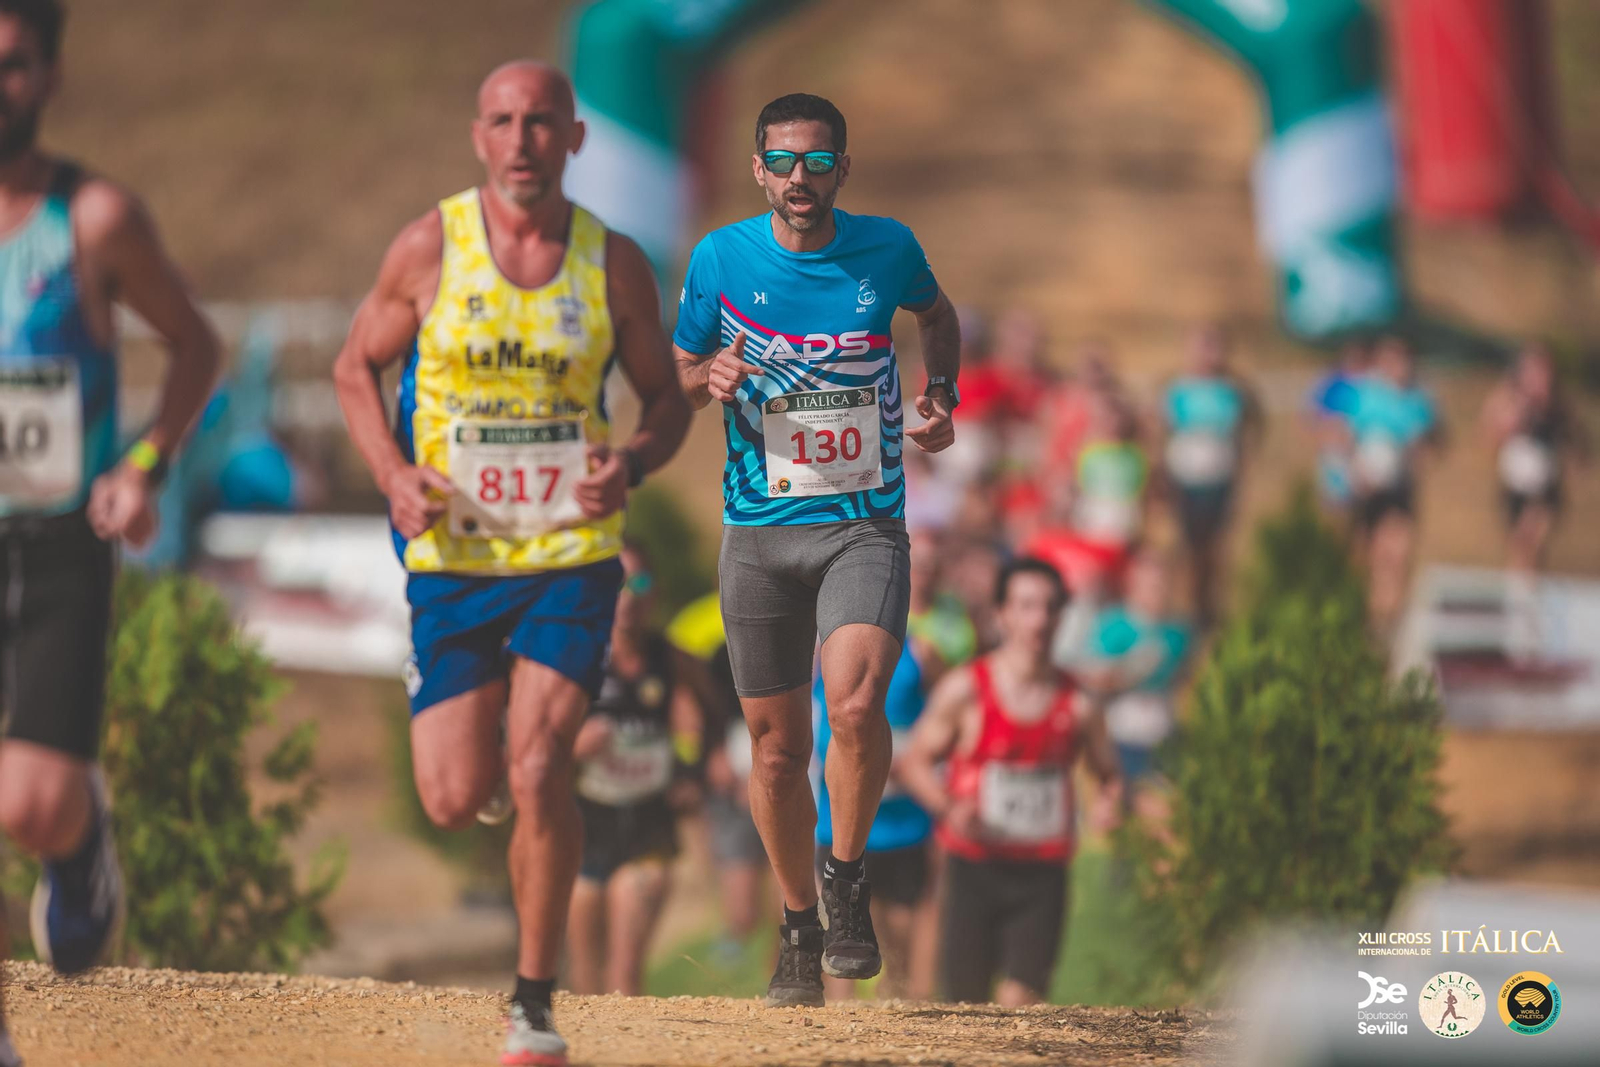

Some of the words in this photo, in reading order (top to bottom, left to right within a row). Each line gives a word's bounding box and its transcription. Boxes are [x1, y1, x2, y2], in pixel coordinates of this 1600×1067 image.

[760, 330, 871, 360] ADS
[796, 394, 850, 408] ITÁLICA
[790, 426, 862, 465] 130
[479, 466, 562, 503] 817
